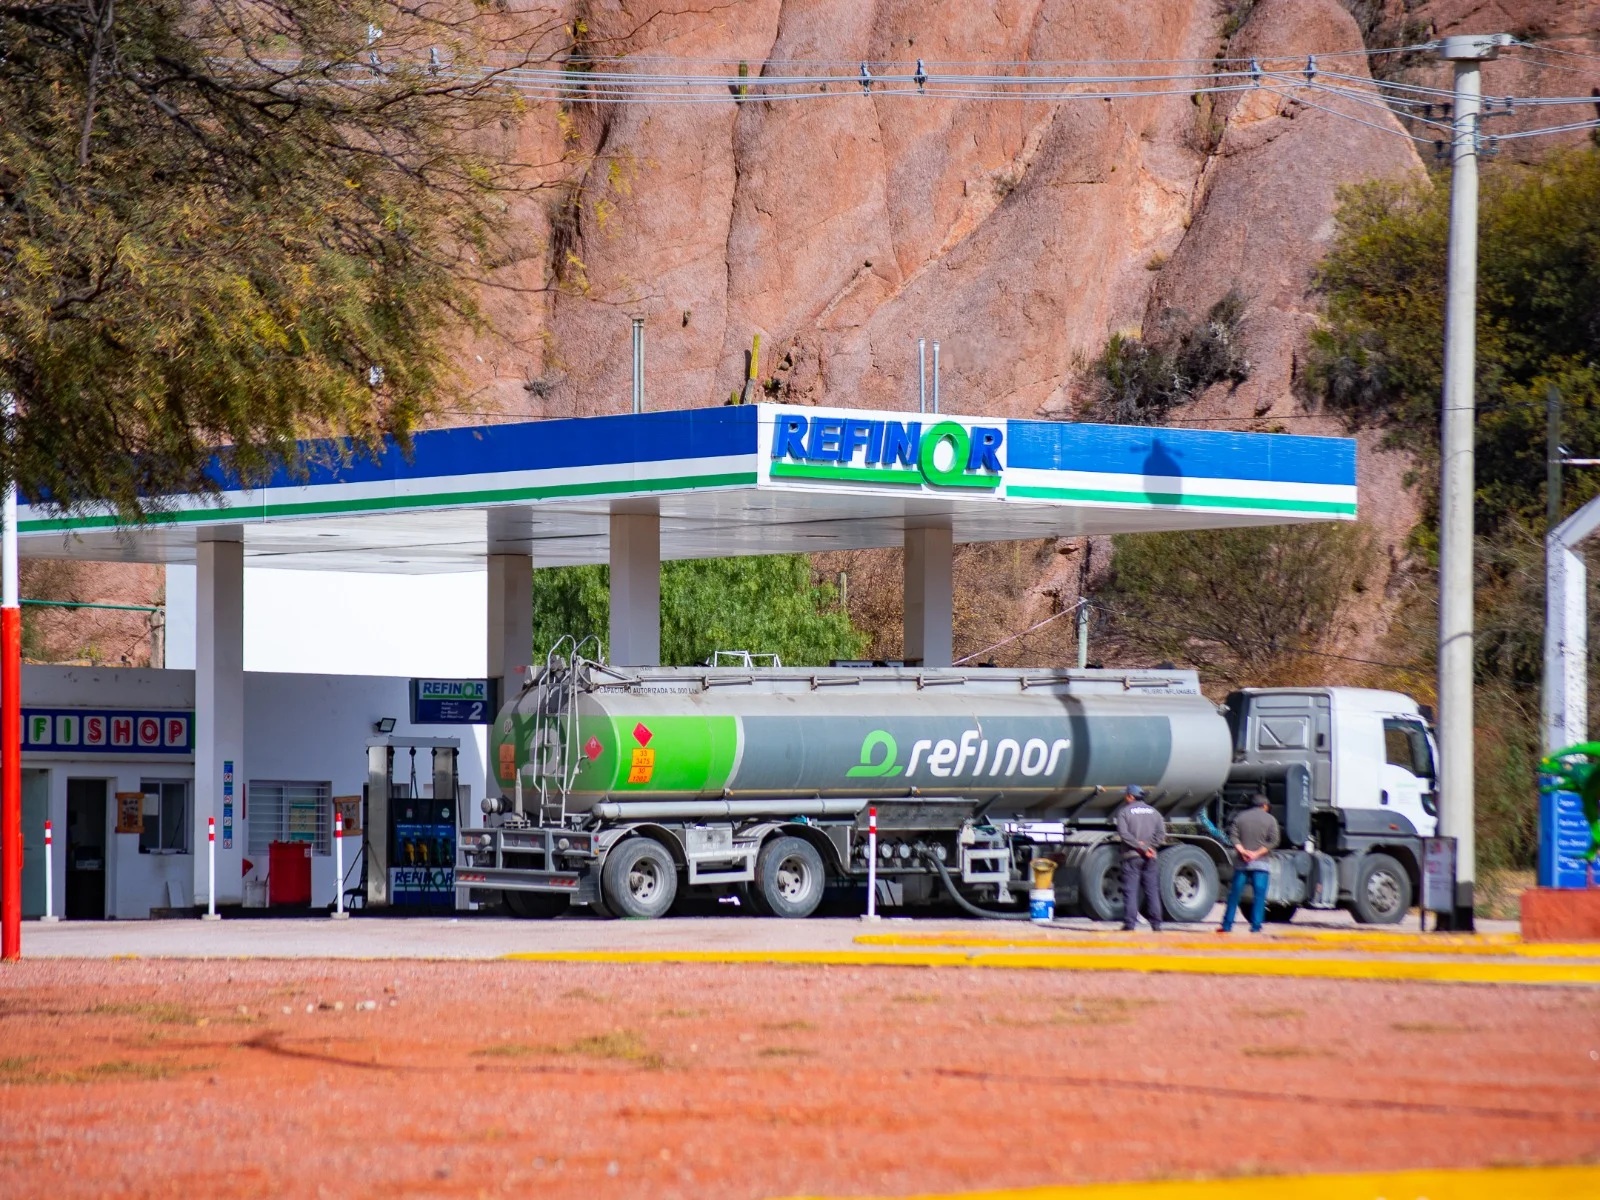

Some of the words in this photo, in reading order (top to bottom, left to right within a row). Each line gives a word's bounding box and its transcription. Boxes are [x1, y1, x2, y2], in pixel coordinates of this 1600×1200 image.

[771, 413, 1003, 487] REFINOR
[423, 682, 484, 699] REFINOR
[468, 702, 483, 720] 2
[905, 730, 1071, 777] refinor
